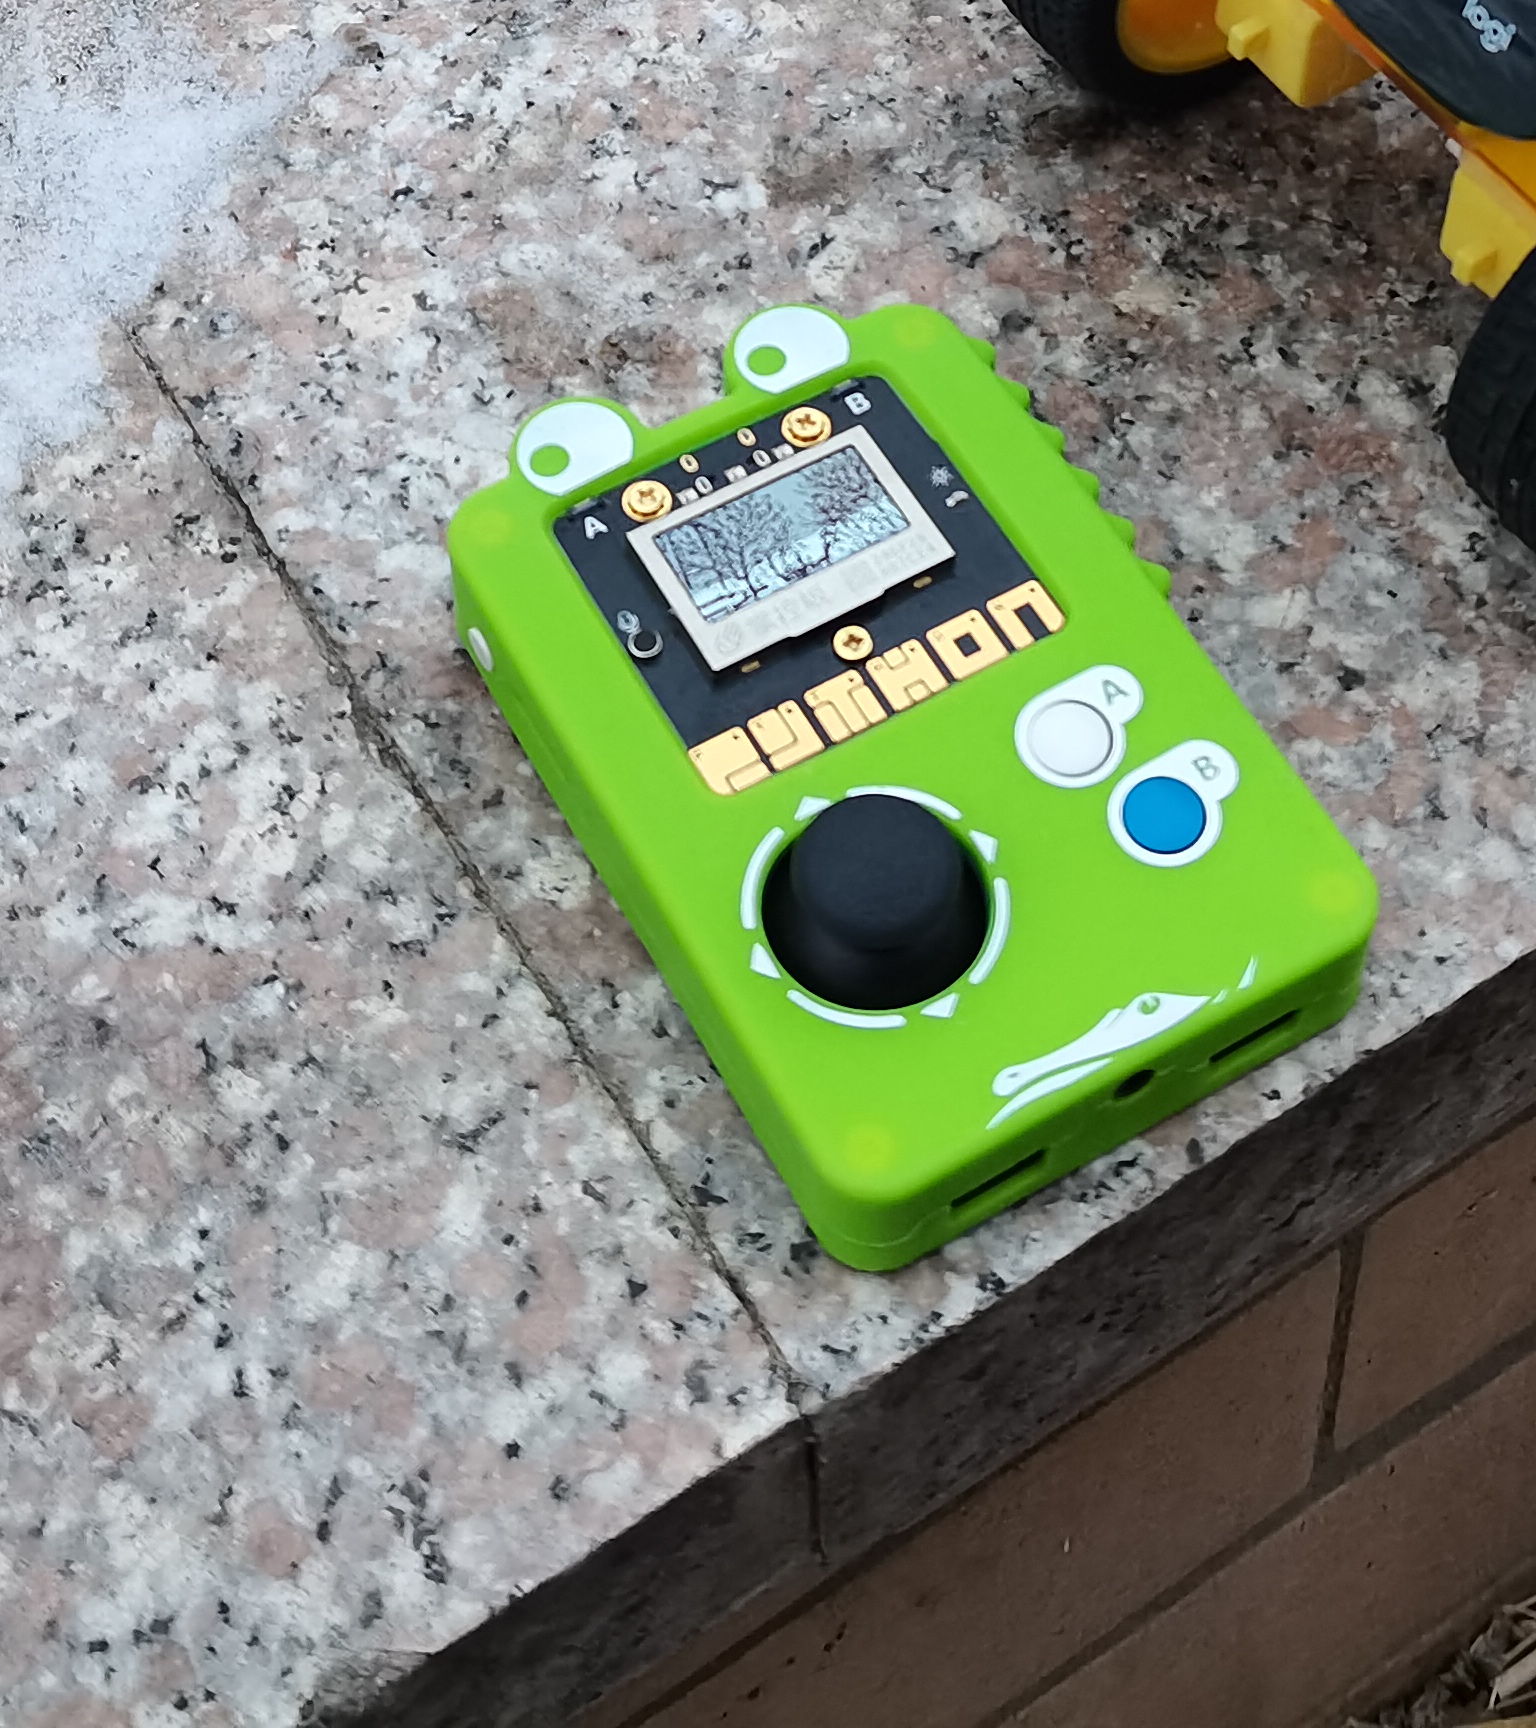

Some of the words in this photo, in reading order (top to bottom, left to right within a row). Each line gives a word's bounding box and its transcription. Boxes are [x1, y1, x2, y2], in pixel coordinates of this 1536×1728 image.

[844, 391, 872, 416] B
[583, 515, 609, 540] A
[1101, 679, 1130, 706] A
[1191, 755, 1221, 781] B
